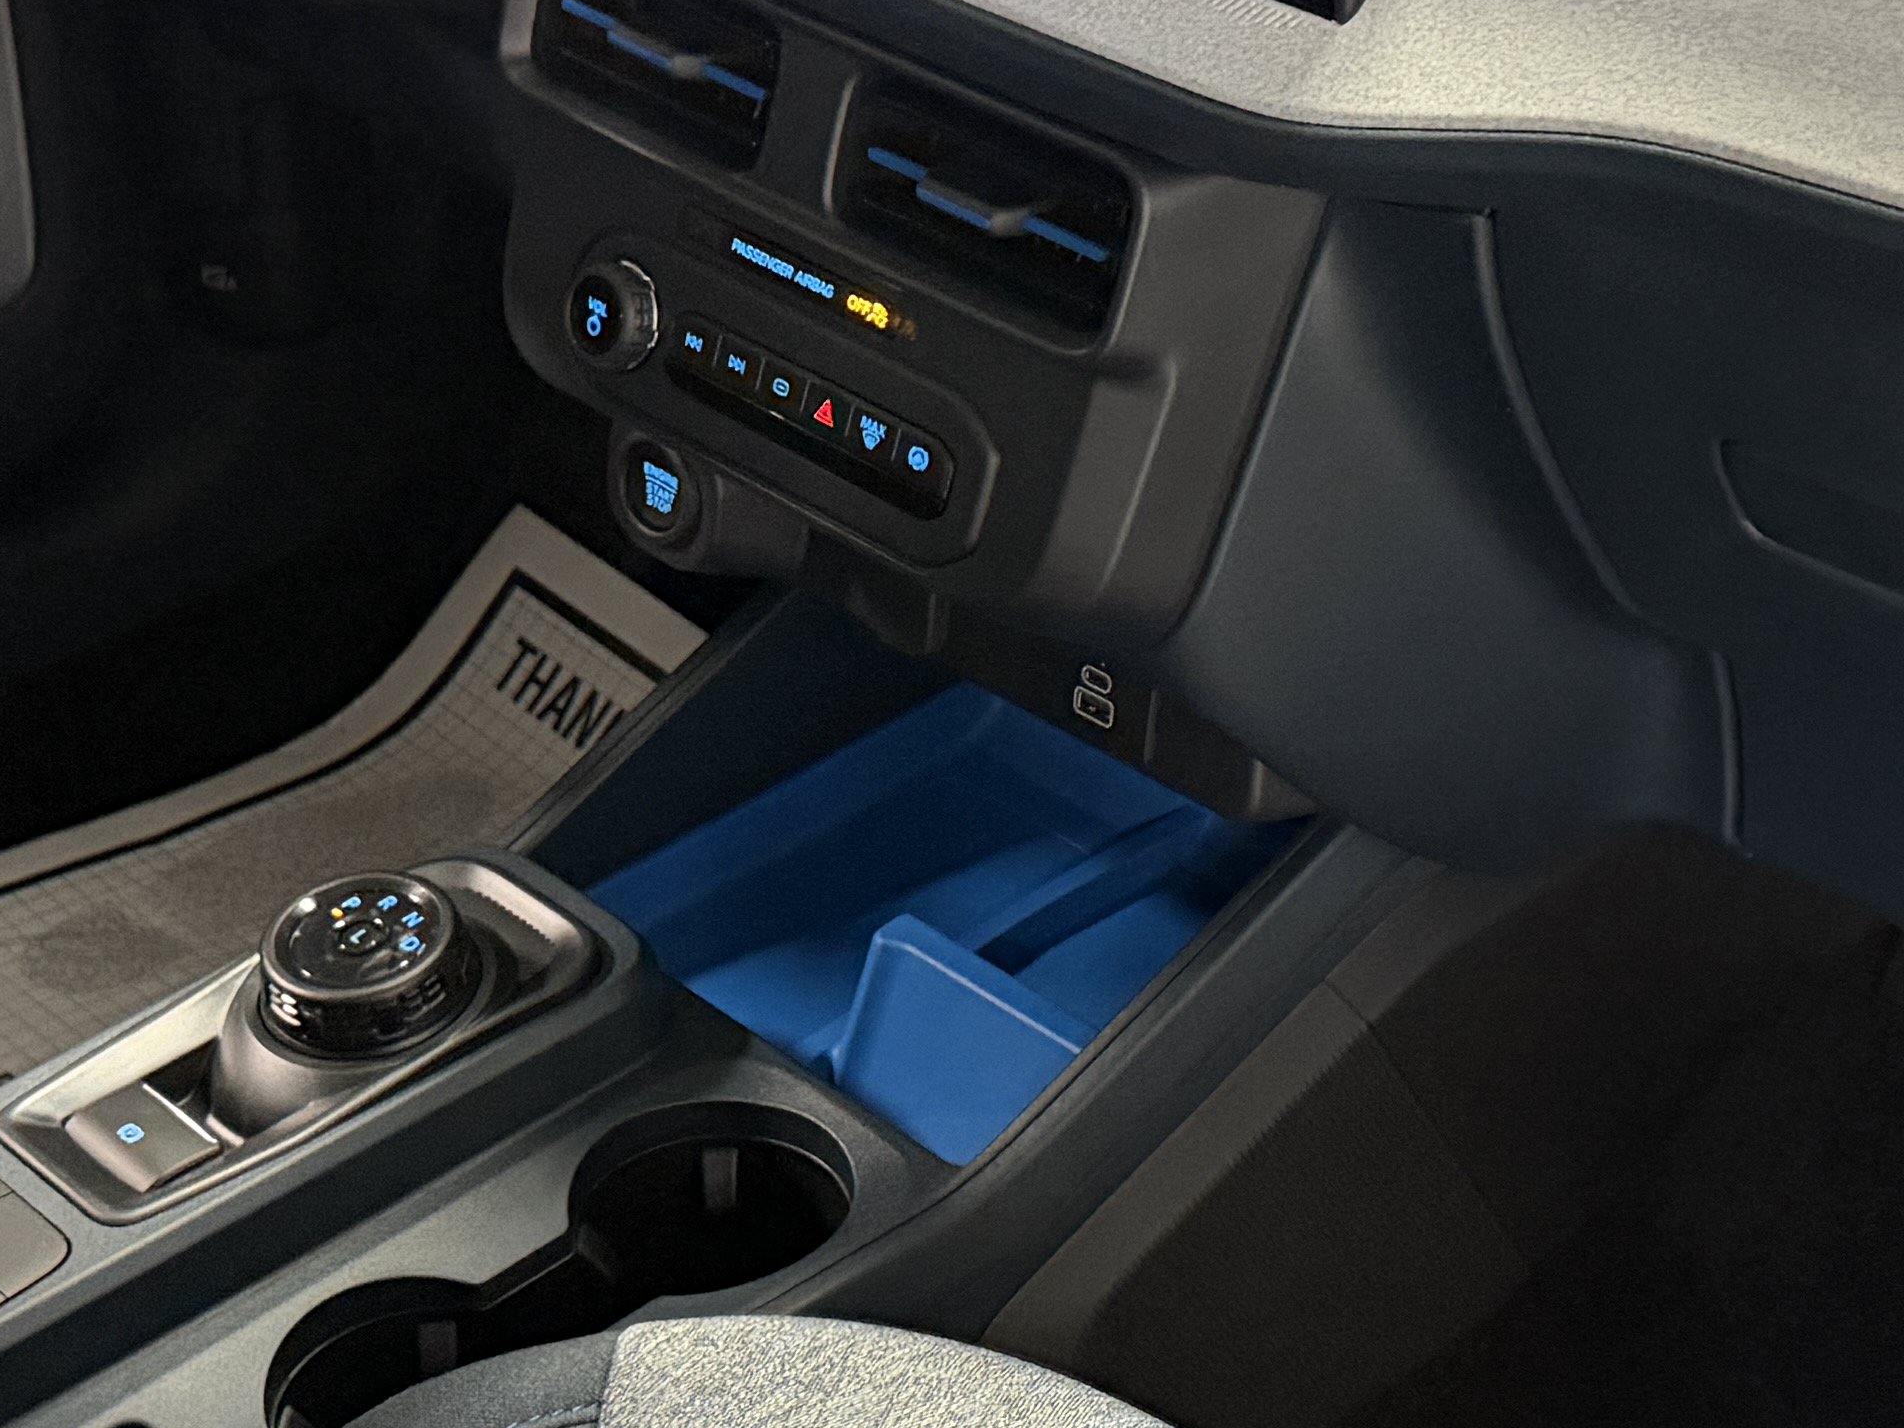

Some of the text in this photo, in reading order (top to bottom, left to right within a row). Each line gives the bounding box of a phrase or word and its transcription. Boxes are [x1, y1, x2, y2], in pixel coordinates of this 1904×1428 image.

[731, 237, 873, 316] PASSENGER AIRBAG OFF
[859, 415, 887, 439] MAX
[645, 481, 676, 505] START
[645, 493, 673, 515] STOP
[341, 896, 362, 908] P
[377, 895, 398, 911] R
[401, 911, 425, 928] N
[350, 928, 366, 945] L
[399, 935, 420, 953] D
